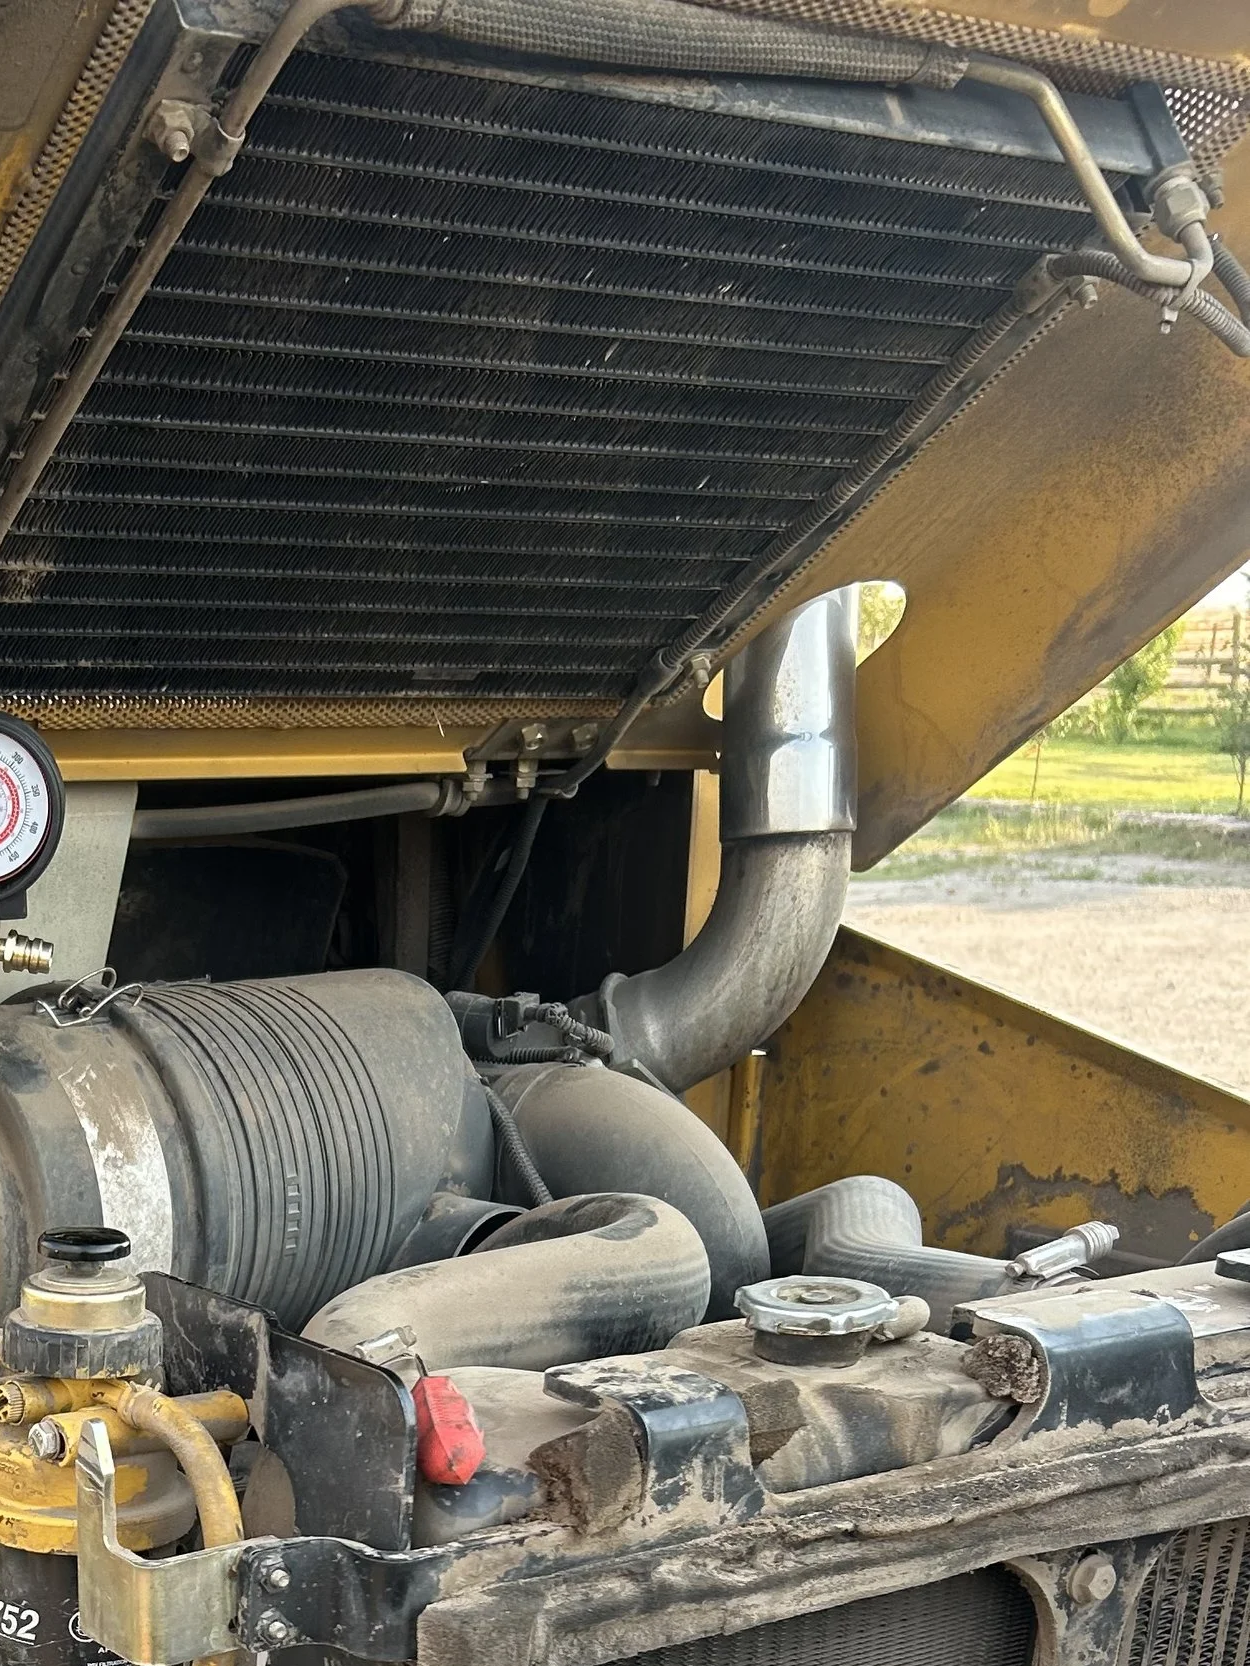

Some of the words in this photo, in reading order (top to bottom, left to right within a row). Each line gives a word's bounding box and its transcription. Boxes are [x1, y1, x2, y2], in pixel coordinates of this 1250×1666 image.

[12, 752, 23, 764] 300
[31, 784, 40, 797] 350
[29, 821, 39, 834] 400
[8, 851, 20, 862] 450
